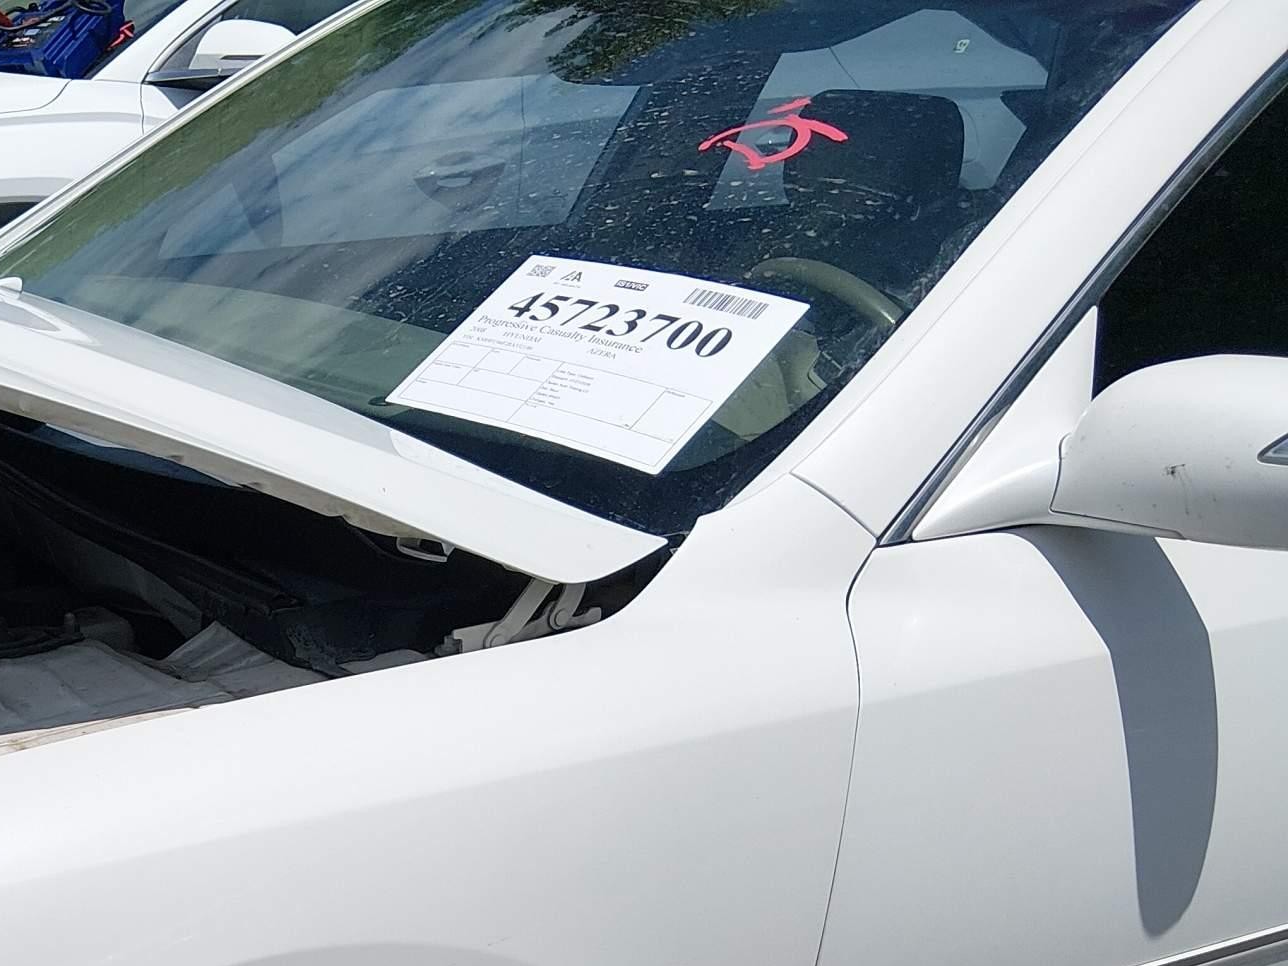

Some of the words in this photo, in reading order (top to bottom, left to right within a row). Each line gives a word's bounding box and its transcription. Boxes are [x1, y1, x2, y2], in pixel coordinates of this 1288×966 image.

[479, 315, 537, 332] Progressive
[539, 325, 586, 343] Casualty
[587, 334, 643, 354] Insurance
[507, 292, 733, 358] 45723700
